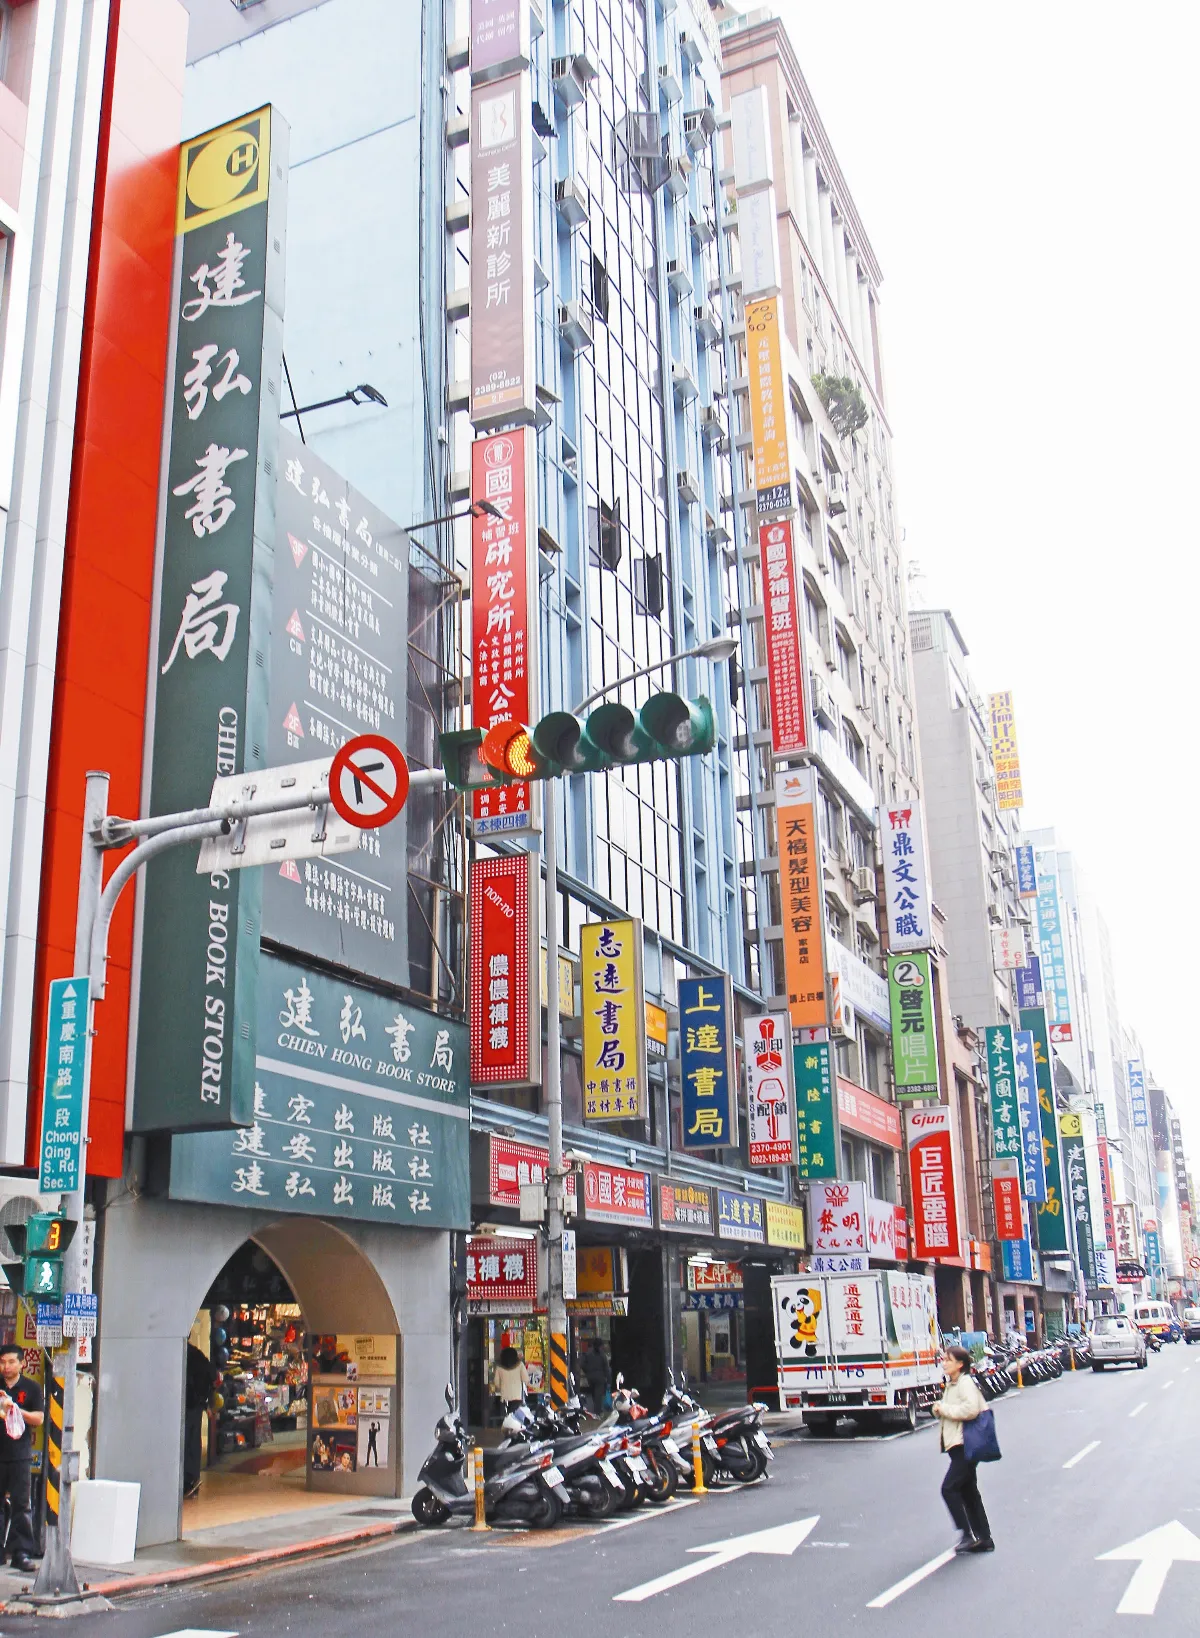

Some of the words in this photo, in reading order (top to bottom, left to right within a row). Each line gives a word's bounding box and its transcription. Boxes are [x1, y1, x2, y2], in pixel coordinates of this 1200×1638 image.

[486, 163, 511, 308] 美麗新診所
[161, 231, 261, 675] 建弘書局
[485, 464, 513, 527] 國家
[481, 522, 520, 543] 補習班
[484, 537, 515, 636] 研究所
[766, 542, 792, 631] 國家補習班
[214, 705, 239, 780] CHIE
[476, 813, 527, 833] 本棟四樓
[484, 885, 515, 919] non-no
[785, 819, 812, 933] 天禧髮型美容
[892, 832, 923, 937] 鼎文公職
[204, 898, 229, 987] BOOK
[278, 977, 455, 1074] 建弘書局
[488, 954, 509, 1049] 儂儂褲襪
[55, 1001, 77, 1128] 重慶南路一段
[200, 997, 227, 1105] STORE
[277, 1032, 328, 1058] CHIEN
[331, 1047, 372, 1071] HONG
[377, 1061, 412, 1083] BOOK
[416, 1072, 456, 1094] STORE
[685, 985, 723, 1138] 上達書局
[753, 1038, 783, 1054] 刻印
[586, 1077, 637, 1096] 中醫書籍
[991, 1029, 1013, 1123] 東大圖書
[45, 1130, 80, 1145] Chong
[253, 1081, 432, 1146] 建宏出版社
[757, 1101, 788, 1119] 配鎖
[911, 1113, 945, 1129] Gjun
[43, 1160, 55, 1174] S.
[59, 1159, 77, 1173] Rd.
[44, 1146, 72, 1160] Qing
[232, 1121, 432, 1180] 建安出版社
[1007, 1126, 1021, 1153] 股份
[43, 1176, 67, 1190] Sec.
[69, 1175, 75, 1188] 1
[230, 1160, 432, 1215] 建弘出版社
[599, 1170, 627, 1207] 國家
[919, 1146, 949, 1249] 巨匠電腦
[50, 1222, 61, 1250] 3
[719, 1196, 761, 1227] 上達書局
[818, 1208, 860, 1235] 黎明
[814, 1257, 862, 1272] 鼎文公職
[816, 1235, 864, 1249] 文化公司
[843, 1284, 865, 1336] 通盈通運
